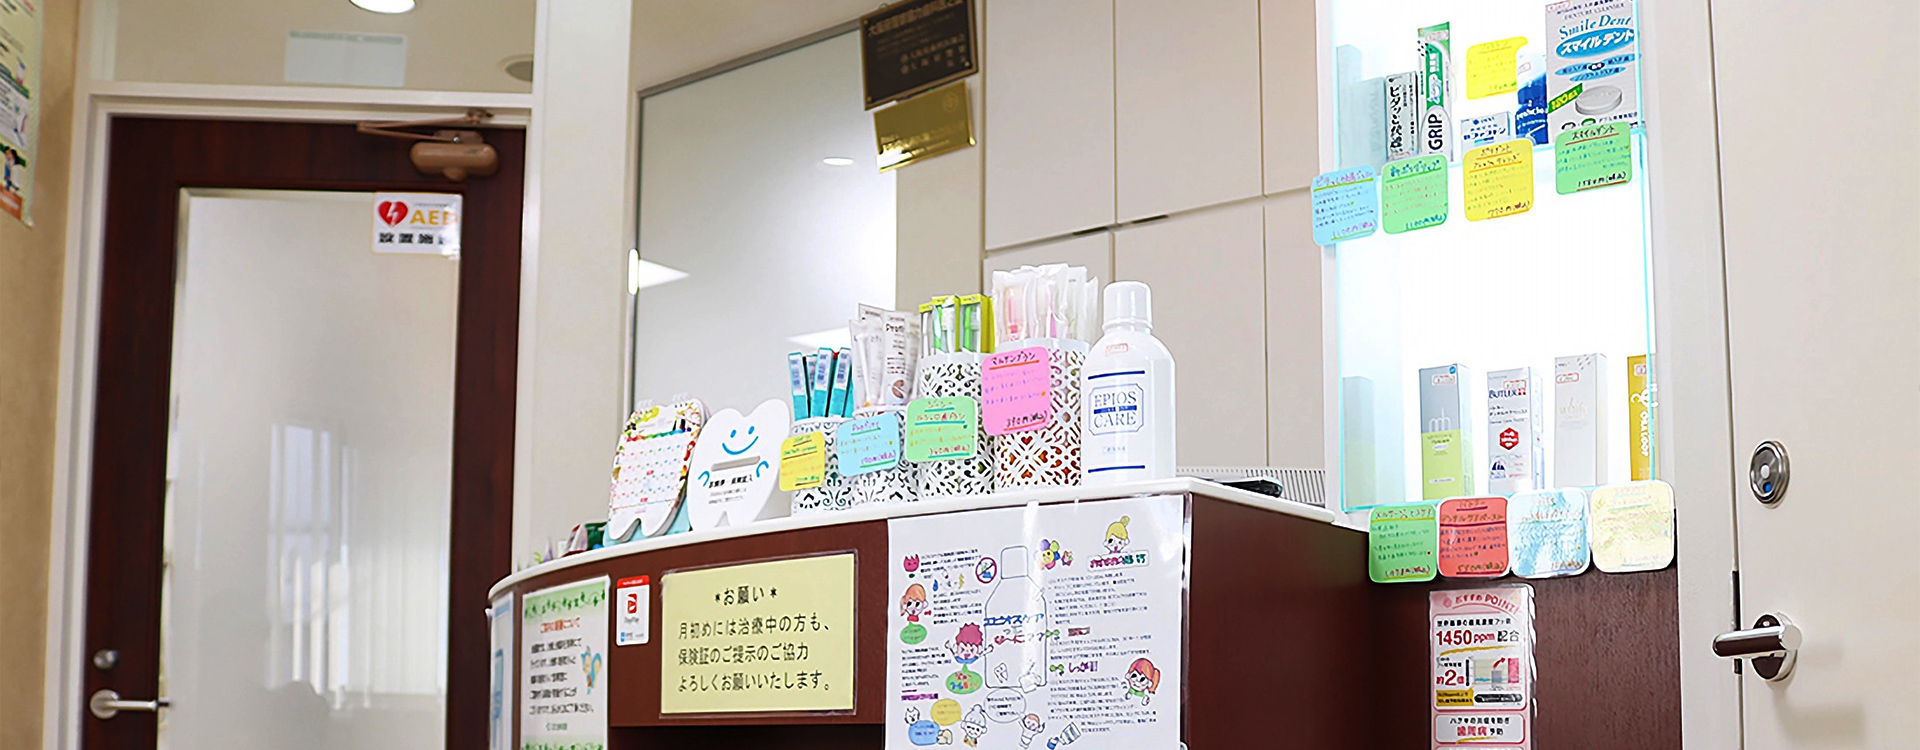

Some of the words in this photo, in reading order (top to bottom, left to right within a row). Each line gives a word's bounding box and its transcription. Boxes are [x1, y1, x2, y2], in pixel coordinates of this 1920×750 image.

[1559, 18, 1597, 40] Smile
[1599, 14, 1632, 27] Dent
[1560, 29, 1634, 55] スマイルデント
[1428, 114, 1443, 150] GRIP
[410, 209, 458, 226] AED
[1094, 390, 1137, 407] EPIOS
[1094, 412, 1137, 428] CARE
[678, 612, 830, 640] 月初めには治療中の方も、
[678, 642, 809, 666] 保険証のご提示のご協力
[678, 669, 830, 692] よろしくお願いいたします。
